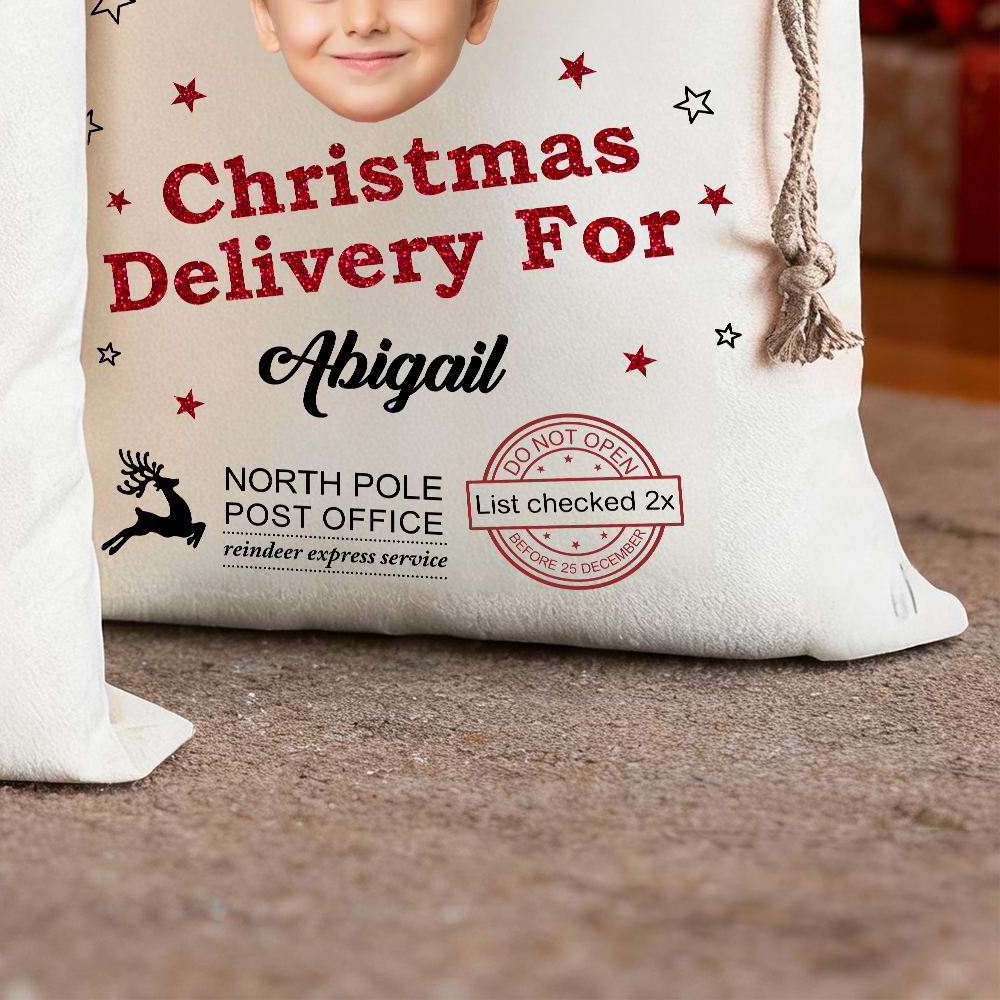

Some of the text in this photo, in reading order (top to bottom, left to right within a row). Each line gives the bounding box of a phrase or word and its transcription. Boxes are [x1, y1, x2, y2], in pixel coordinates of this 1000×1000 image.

[163, 127, 640, 224] Christmas
[103, 205, 681, 313] Delivery For
[258, 330, 509, 418] Abigail
[503, 429, 639, 476] DO NOT OPEN
[225, 467, 443, 501] NORTH POLE
[476, 490, 675, 515] List checked 2x
[225, 502, 443, 535] POST OFFICE
[223, 541, 448, 569] reindeer express service
[508, 528, 647, 575] BEFORE 25 DECEMBER
